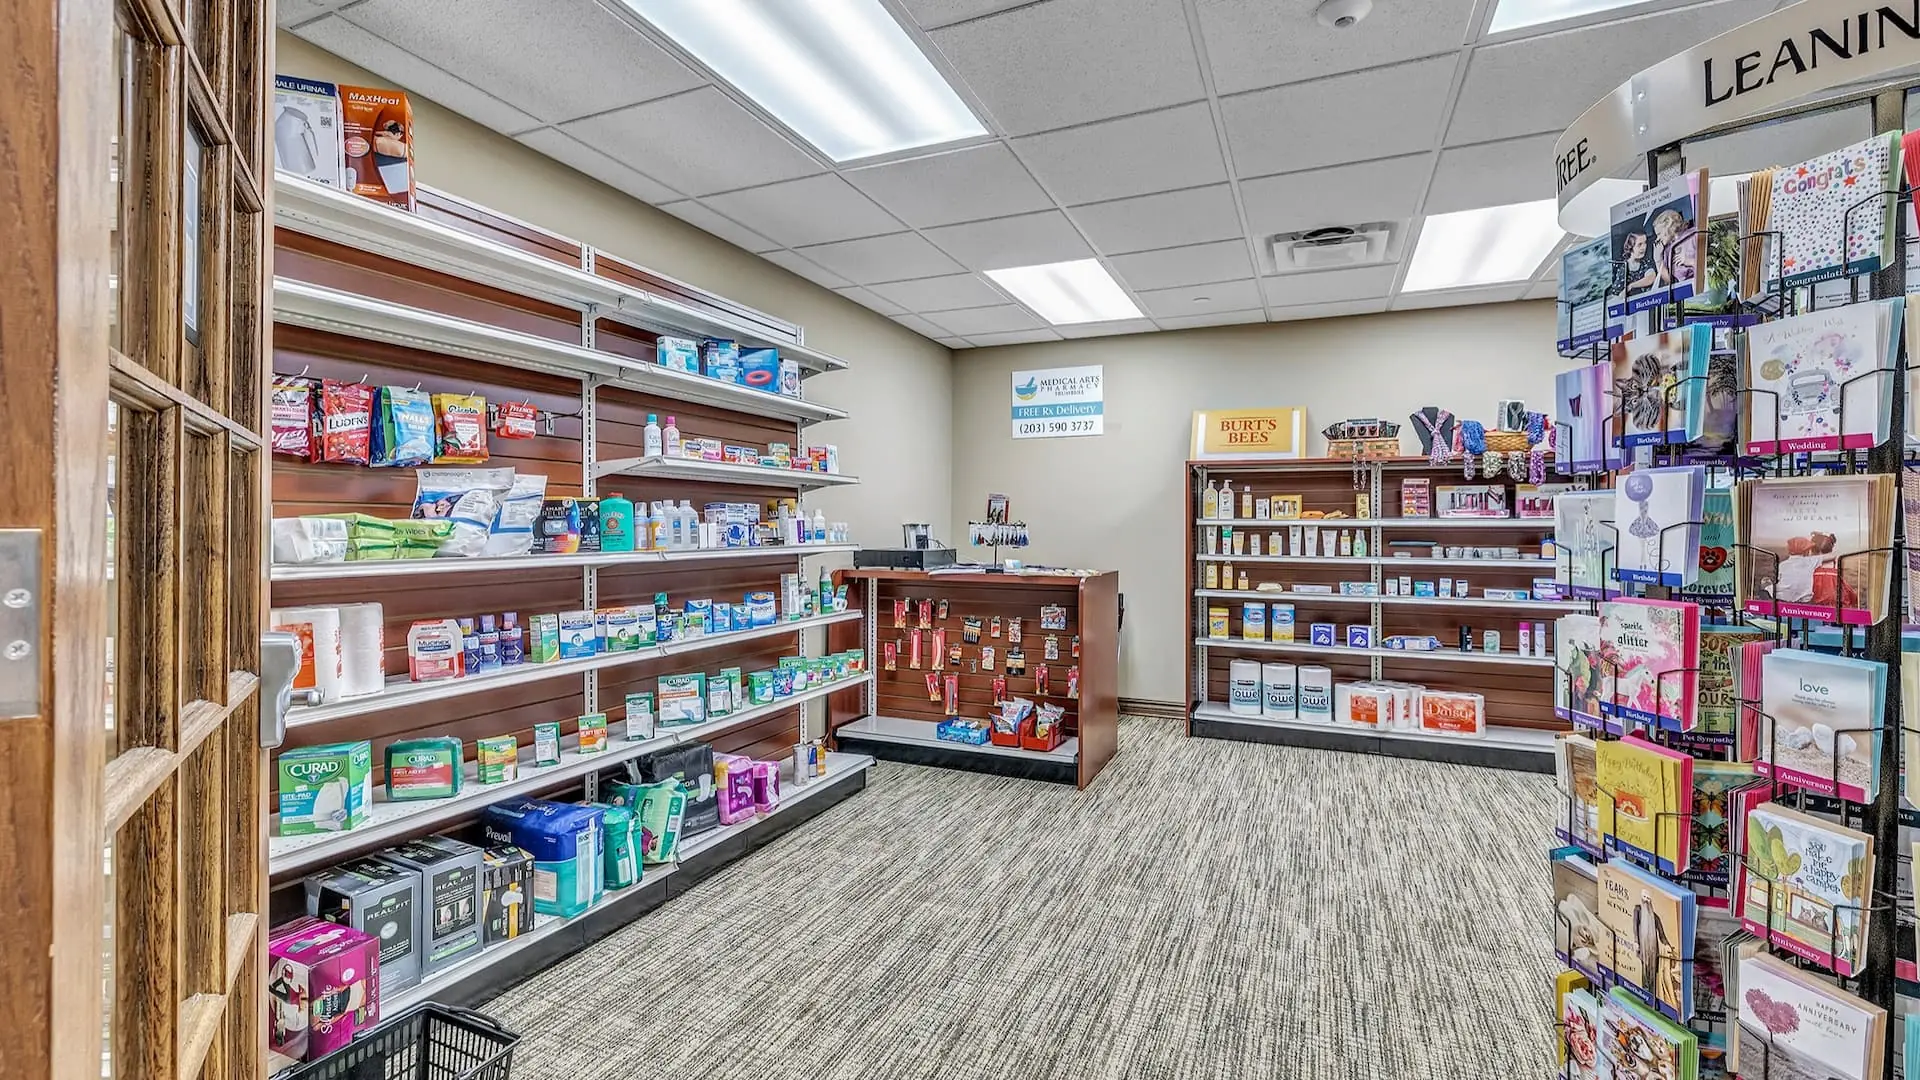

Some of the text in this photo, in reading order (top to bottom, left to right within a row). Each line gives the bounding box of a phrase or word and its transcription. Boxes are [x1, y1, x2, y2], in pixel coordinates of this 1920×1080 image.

[297, 83, 328, 95] URINAL
[349, 92, 400, 105] MAXHeat
[1784, 157, 1866, 194] Congrats
[1635, 297, 1663, 309] Birthday
[1040, 375, 1100, 386] MEDICAL ARTS
[1040, 383, 1099, 392] PHARMACY
[448, 404, 479, 415] Ricola
[1018, 404, 1096, 417] FREE Rx Delivery
[329, 416, 368, 430] LUDEN'S
[1020, 420, 1095, 434] (203) 590 3737
[1220, 419, 1277, 432] BURT'S
[1228, 431, 1269, 444] BEES
[1637, 436, 1662, 444] Birthday
[1788, 440, 1827, 451] Wedding
[1690, 458, 1727, 466] Sympathy
[1704, 533, 1720, 541] and
[1633, 574, 1657, 583] Birthday
[1683, 583, 1733, 594] orever
[1696, 596, 1734, 605] Sympathy
[1781, 605, 1832, 619] Anniversary
[418, 639, 450, 647] Mucinex
[1617, 633, 1649, 648] glitter
[1232, 688, 1260, 698] Towel
[1800, 678, 1829, 695] love
[1267, 692, 1296, 703] Towe
[1699, 691, 1731, 706] OUR
[1428, 702, 1472, 720] Daisy
[1625, 711, 1652, 723] Birthday
[1682, 734, 1735, 744] Pet Sympathy
[408, 754, 436, 763] CURAD
[290, 761, 338, 777] CURAD
[1781, 771, 1834, 792] Anniversary
[486, 826, 511, 843] Prevail
[1810, 865, 1840, 882] happy
[435, 874, 474, 892] REAL FIT
[1806, 875, 1841, 894] camper
[367, 900, 410, 921] REAL FIT
[1769, 934, 1821, 961] Anniversary
[1623, 980, 1650, 1001] Birthday
[321, 984, 332, 1034] Silhouette
[1816, 1001, 1839, 1015] HAPPY
[1798, 1003, 1857, 1034] ANNIVERSARY
